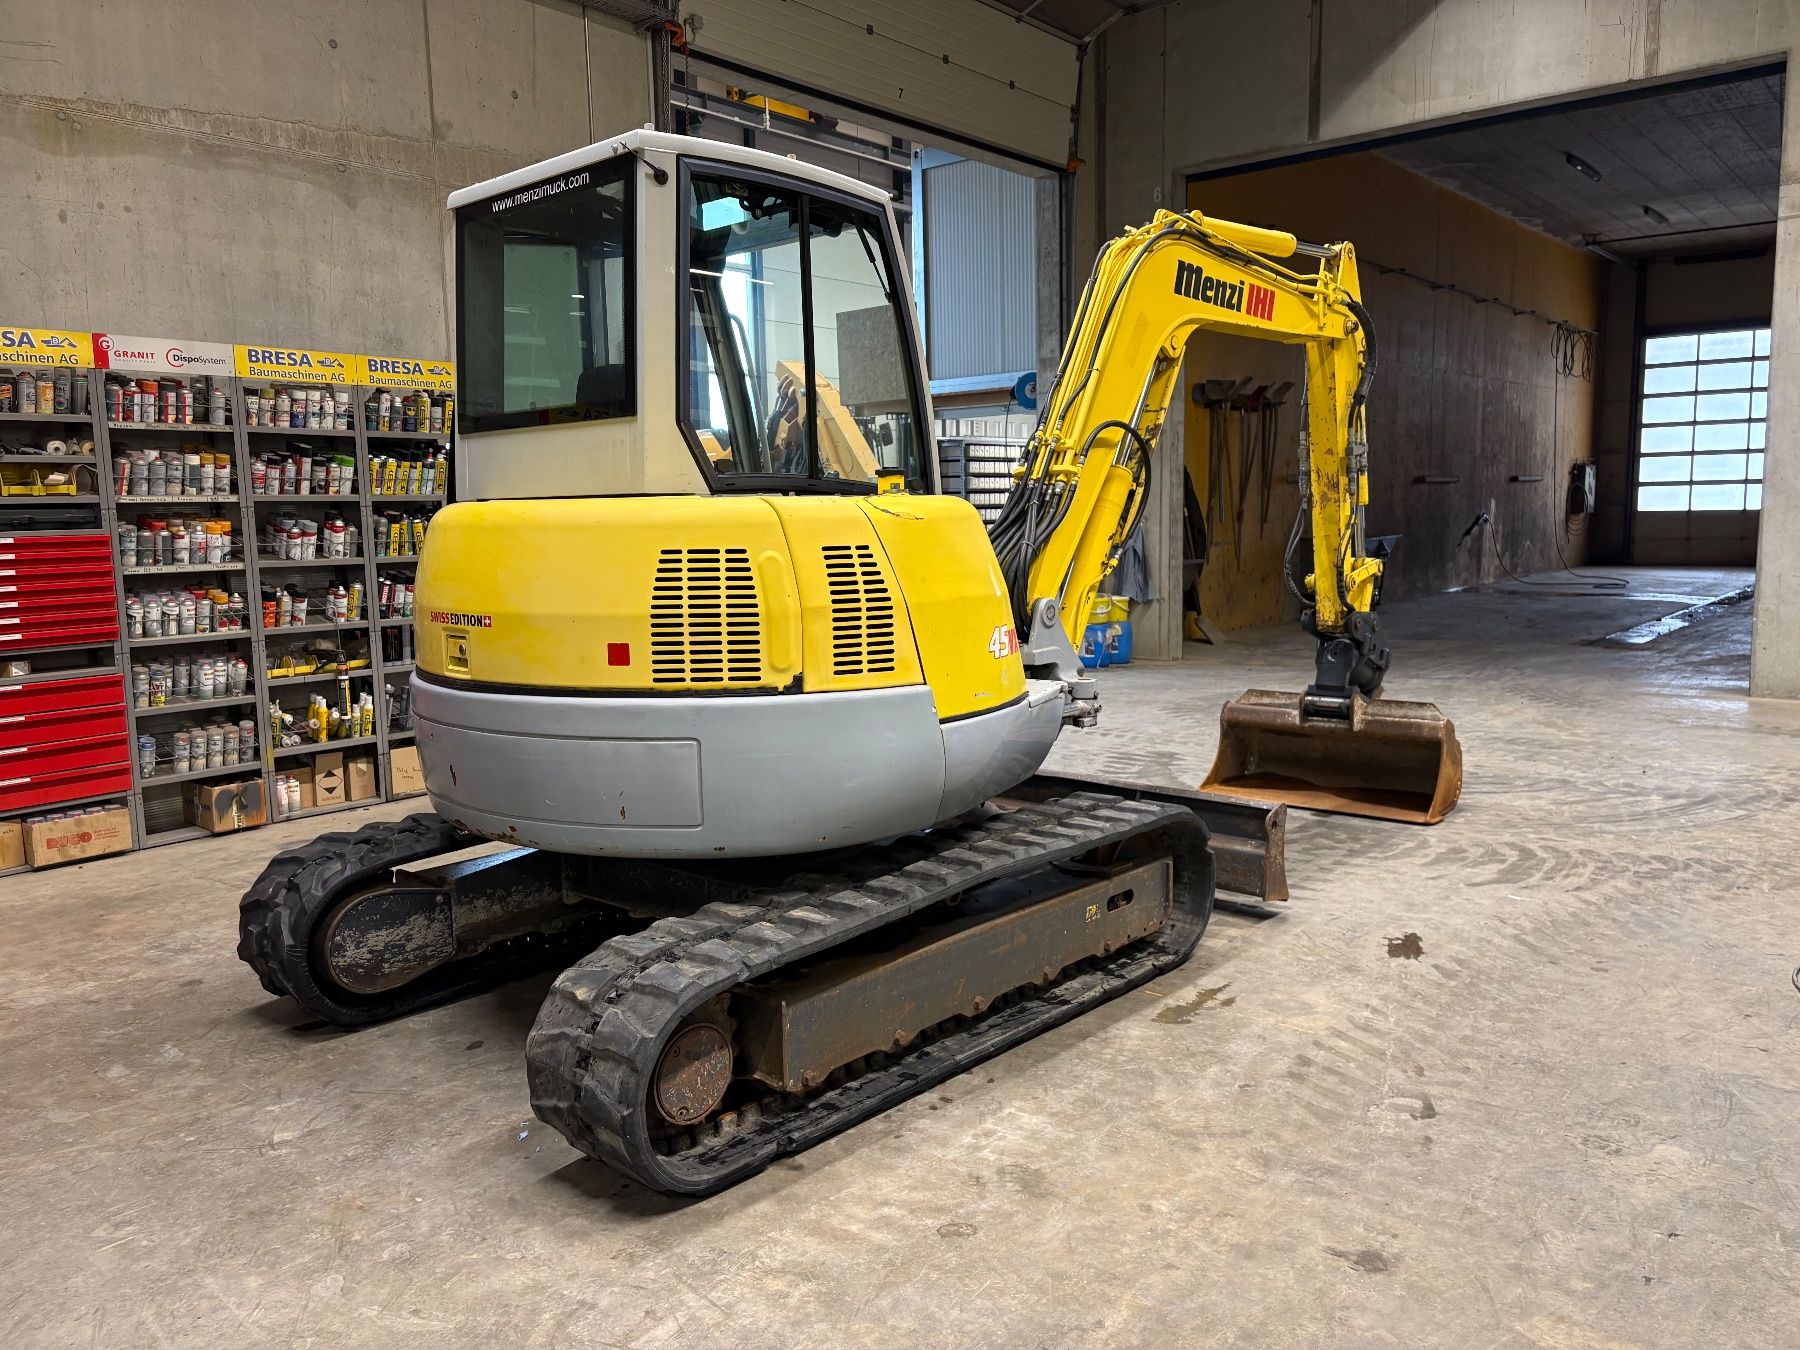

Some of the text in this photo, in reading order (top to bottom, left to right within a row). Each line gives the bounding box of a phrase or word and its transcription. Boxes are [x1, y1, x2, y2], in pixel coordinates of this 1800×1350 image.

[491, 172, 590, 213] www.menzimuck.com
[1173, 259, 1276, 322] Menzi IHI
[0, 351, 79, 365] schinen AG
[113, 349, 156, 360] GRANIT
[172, 354, 227, 366] DispoSystem
[247, 348, 313, 368] BRESA
[249, 366, 345, 383] Baumaschinen AG
[367, 358, 424, 376] BRESA
[369, 374, 452, 389] Baumaschinen AG
